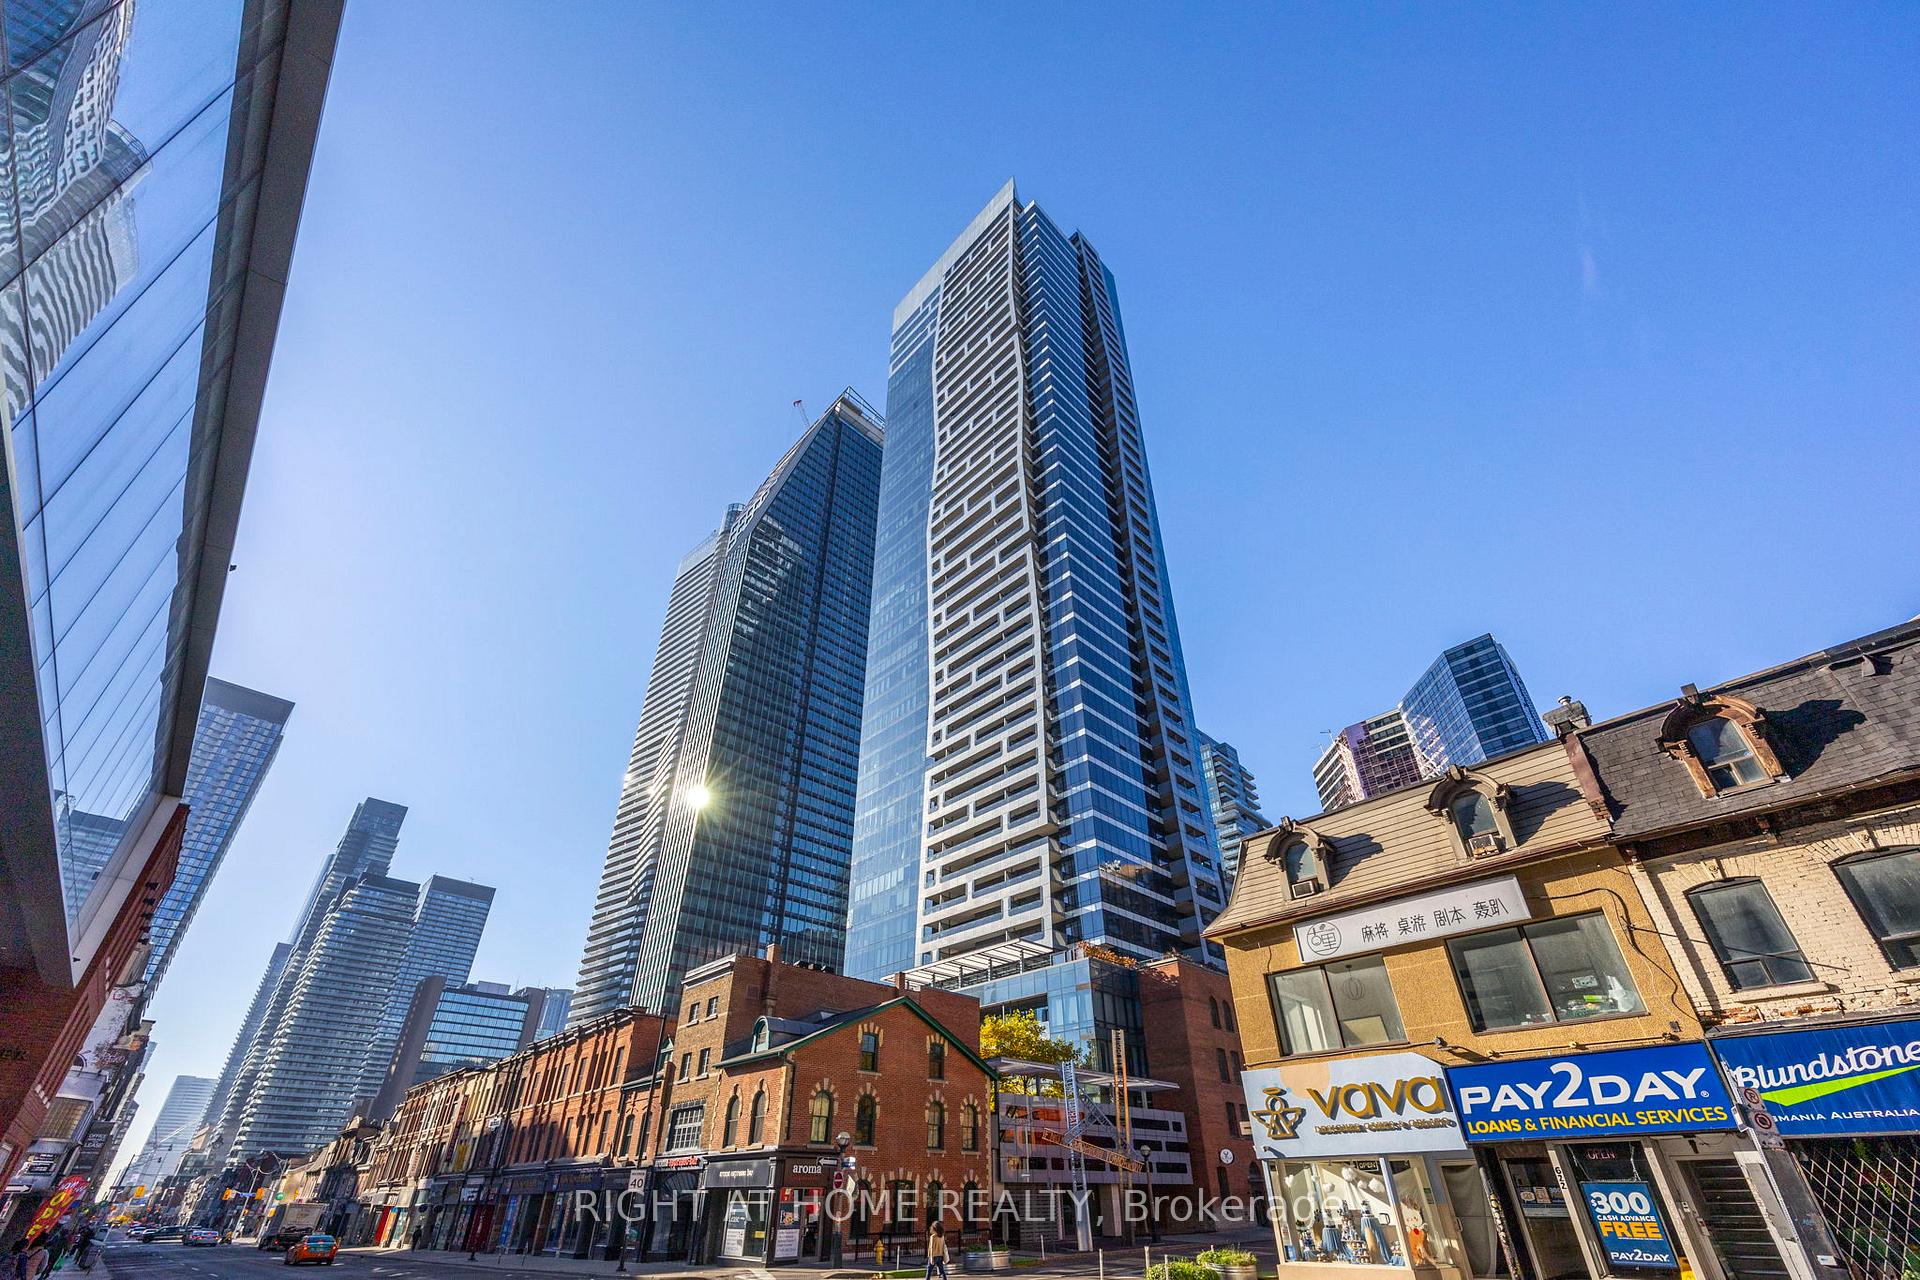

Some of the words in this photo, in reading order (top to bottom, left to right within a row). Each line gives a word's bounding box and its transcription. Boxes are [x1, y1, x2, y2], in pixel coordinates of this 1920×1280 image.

[1361, 922, 1389, 943] 麻将
[1398, 914, 1427, 936] 桌游
[1434, 906, 1466, 928] 剧本
[1735, 1041, 1920, 1090] Blundstone
[1306, 1076, 1447, 1120] vava
[1459, 1061, 1706, 1115] PAY2DAY
[1467, 1119, 1522, 1135] LOANS
[1525, 1117, 1537, 1131] &
[1539, 1111, 1635, 1130] FINANCIAL
[1635, 1106, 1728, 1125] SERVICES
[1831, 1107, 1920, 1120] AUSTRALIA
[793, 1165, 822, 1174] aroma
[1359, 1161, 1376, 1169] OPEN
[630, 1178, 644, 1188] 40
[1554, 1166, 1568, 1190] 622
[1590, 1191, 1651, 1215] $300
[1620, 1214, 1656, 1222] ADVANCE
[1598, 1221, 1662, 1239] FREE
[1610, 1249, 1670, 1262] PAY2DAY
